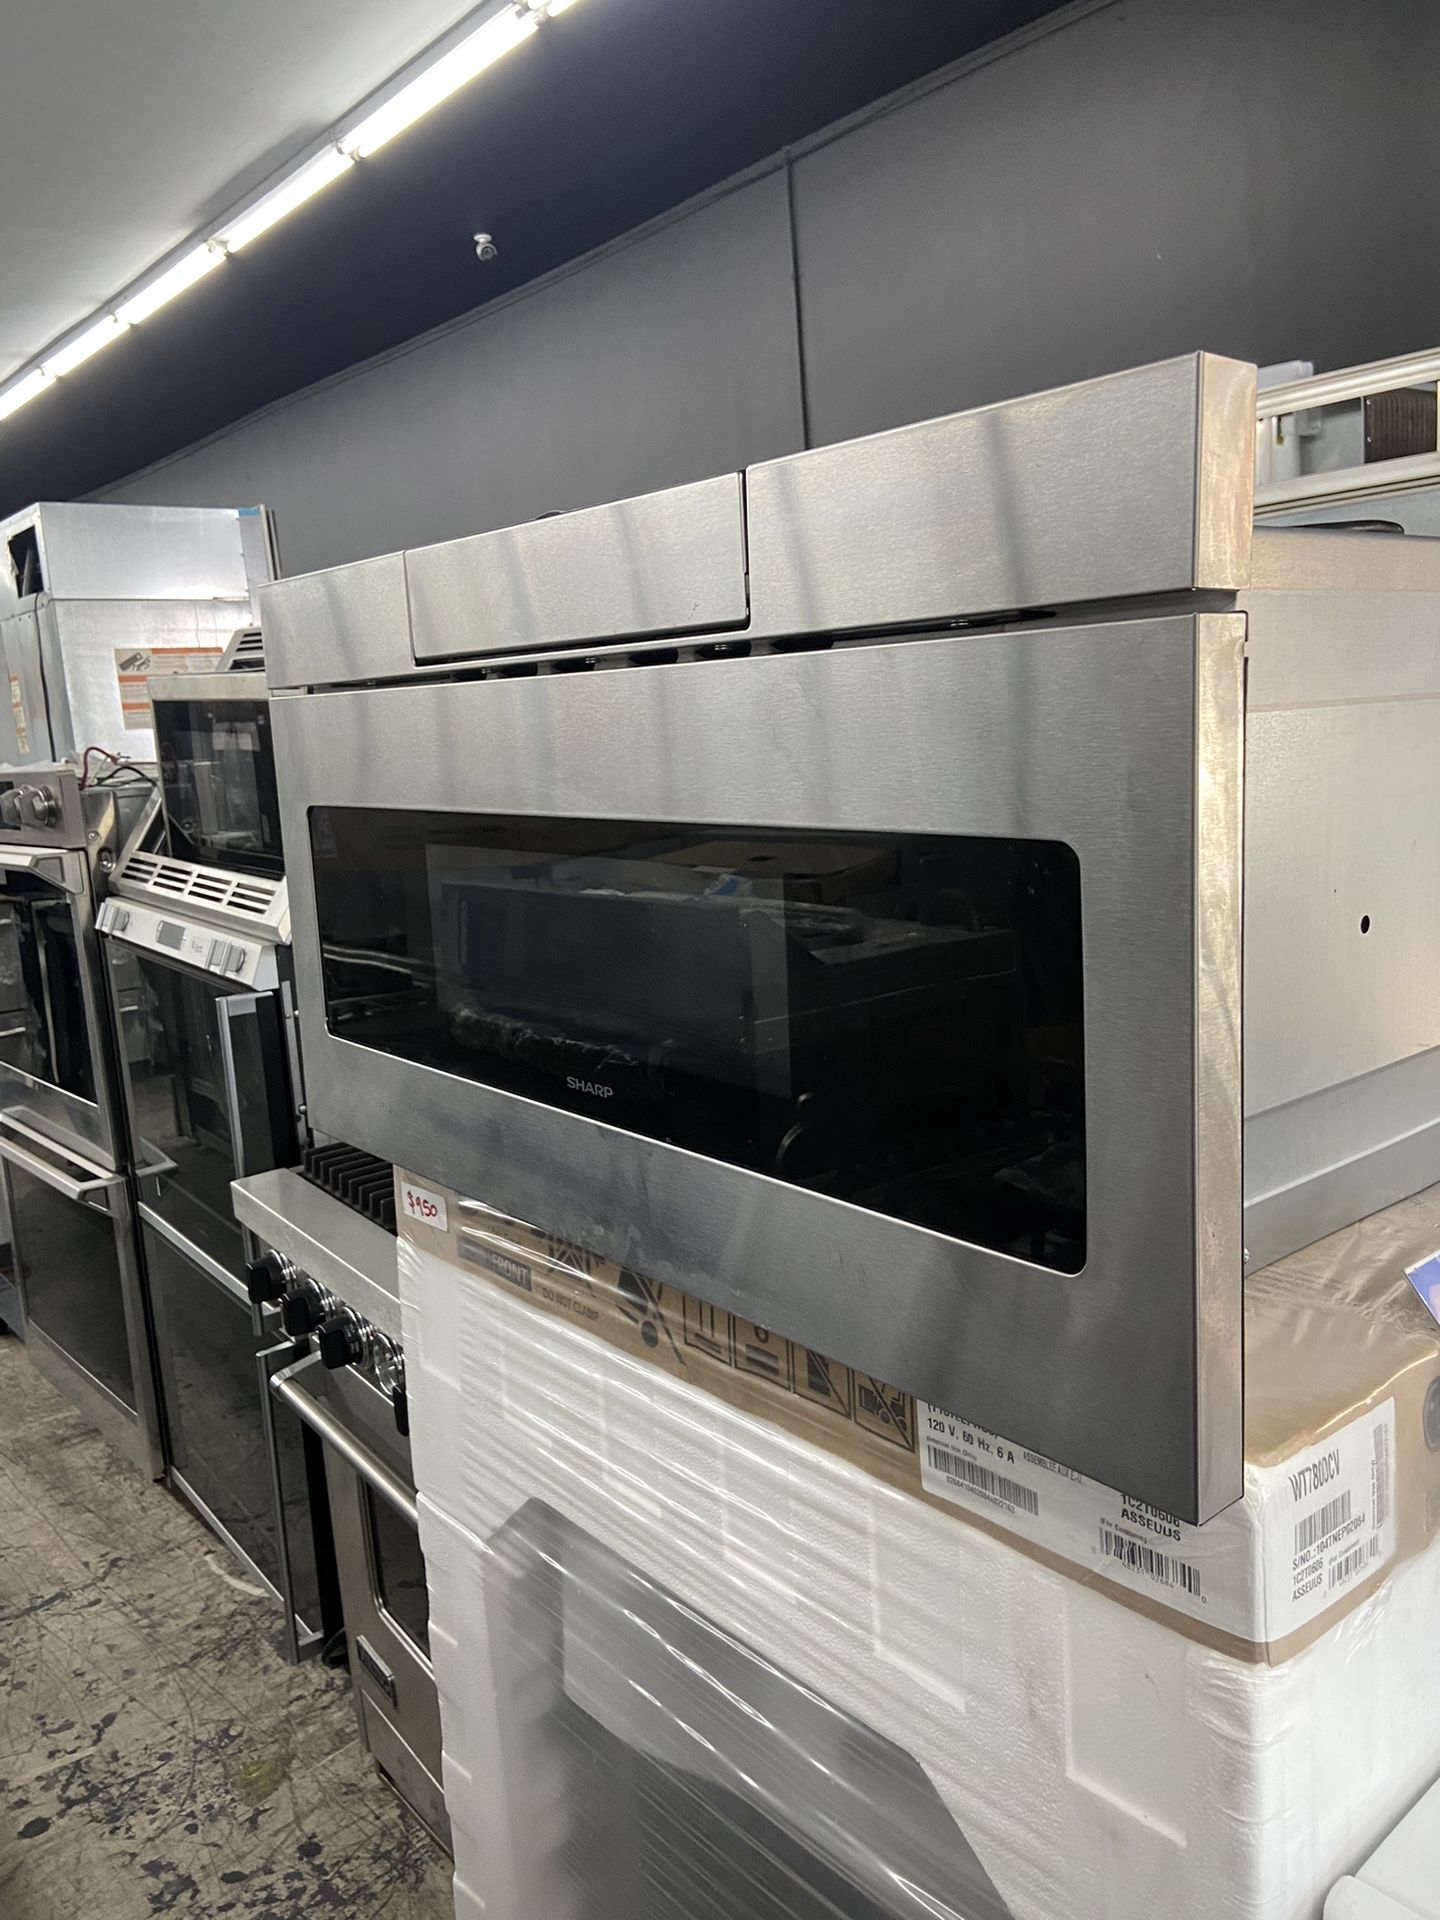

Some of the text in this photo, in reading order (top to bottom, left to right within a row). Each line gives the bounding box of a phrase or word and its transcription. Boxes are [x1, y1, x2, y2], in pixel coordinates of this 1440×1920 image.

[566, 1076, 614, 1098] SHARP
[407, 1190, 438, 1218] $950
[927, 1417, 945, 1433] 120
[962, 1430, 974, 1445] 60
[996, 1445, 1004, 1459] 6
[1006, 1450, 1015, 1464] A
[1121, 1508, 1182, 1542] ASSEUUS
